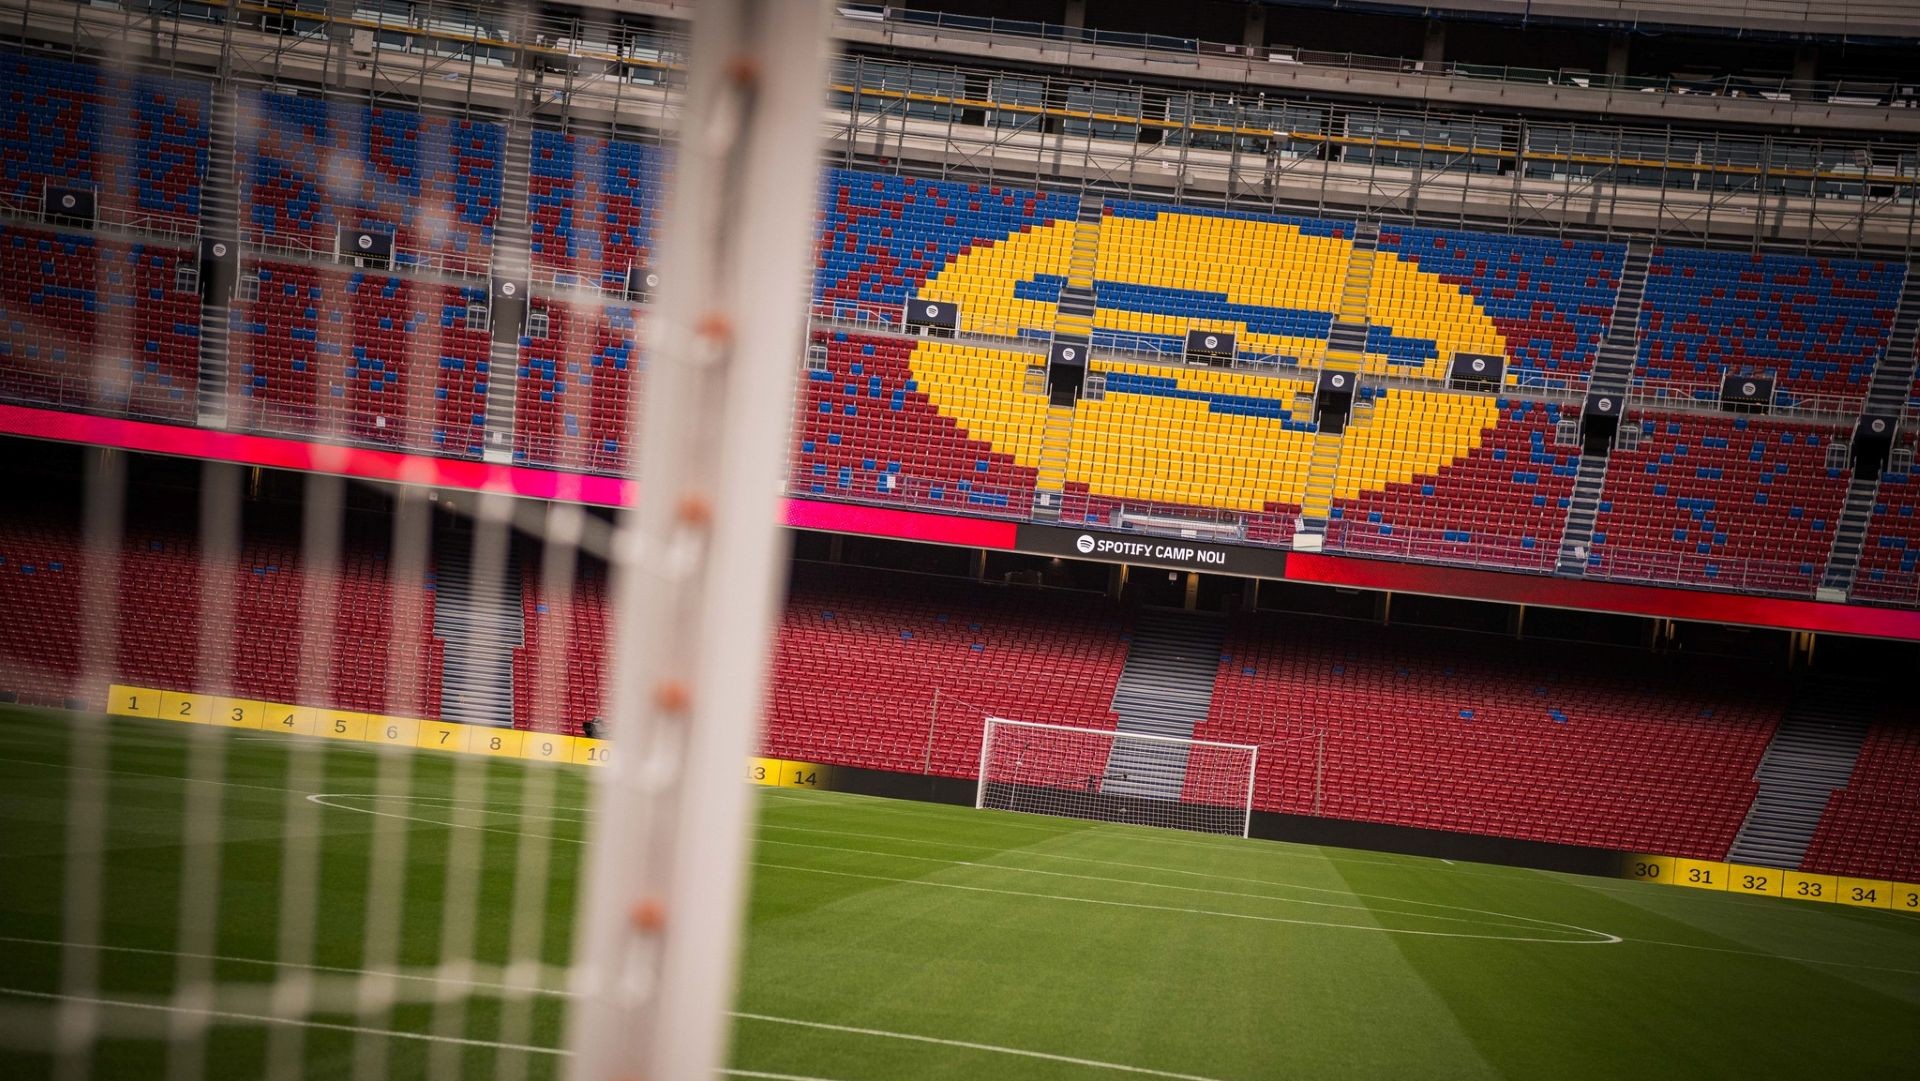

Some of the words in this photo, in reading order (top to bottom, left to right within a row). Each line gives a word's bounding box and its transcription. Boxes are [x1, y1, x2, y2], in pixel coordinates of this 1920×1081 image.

[1097, 540, 1153, 557] SPOTIFY
[1155, 545, 1194, 561] CAMP
[1197, 550, 1226, 564] NOU
[127, 696, 139, 710] 1
[180, 702, 192, 716] 2
[231, 708, 244, 721] 3
[283, 714, 295, 727] 4
[335, 720, 347, 733] 5
[386, 725, 398, 739] 6
[439, 731, 450, 745] 7
[489, 737, 502, 751] 8
[542, 742, 553, 756] 9
[587, 747, 611, 762] 10
[794, 770, 817, 785] 14
[1635, 862, 1660, 878] 30
[1688, 868, 1713, 884] 31
[1742, 875, 1768, 891] 32
[1797, 881, 1822, 897] 33
[1851, 887, 1877, 903] 34
[1906, 893, 1920, 907] 3
